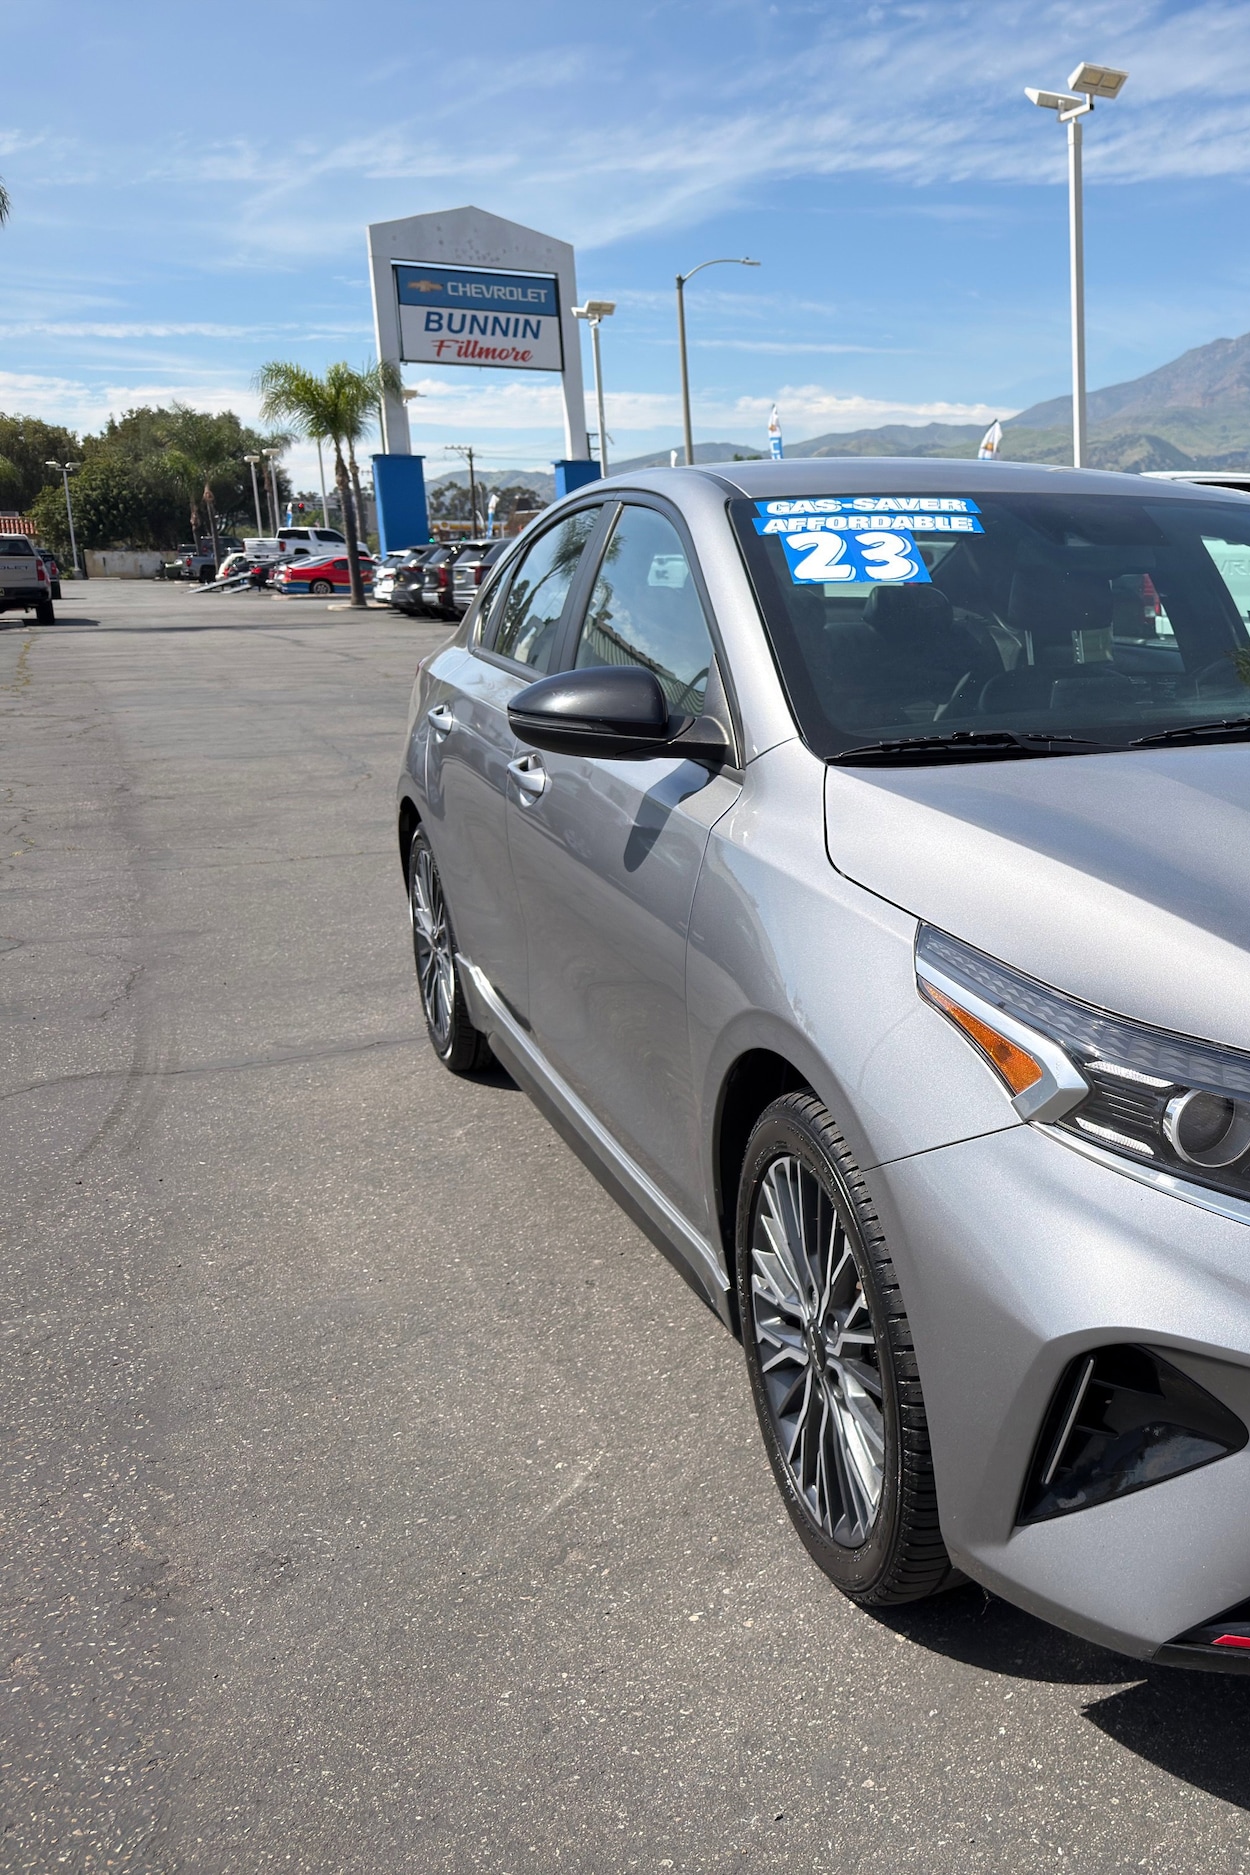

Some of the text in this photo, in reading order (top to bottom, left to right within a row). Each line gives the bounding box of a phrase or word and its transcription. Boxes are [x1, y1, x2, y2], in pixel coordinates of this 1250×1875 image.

[447, 281, 548, 303] CHEVROLET
[424, 311, 541, 340] BUNNIN
[431, 339, 533, 362] Fillmore
[765, 497, 968, 516] GAS-SAVER
[763, 515, 974, 534] AFFORDABLE
[786, 531, 919, 582] 23
